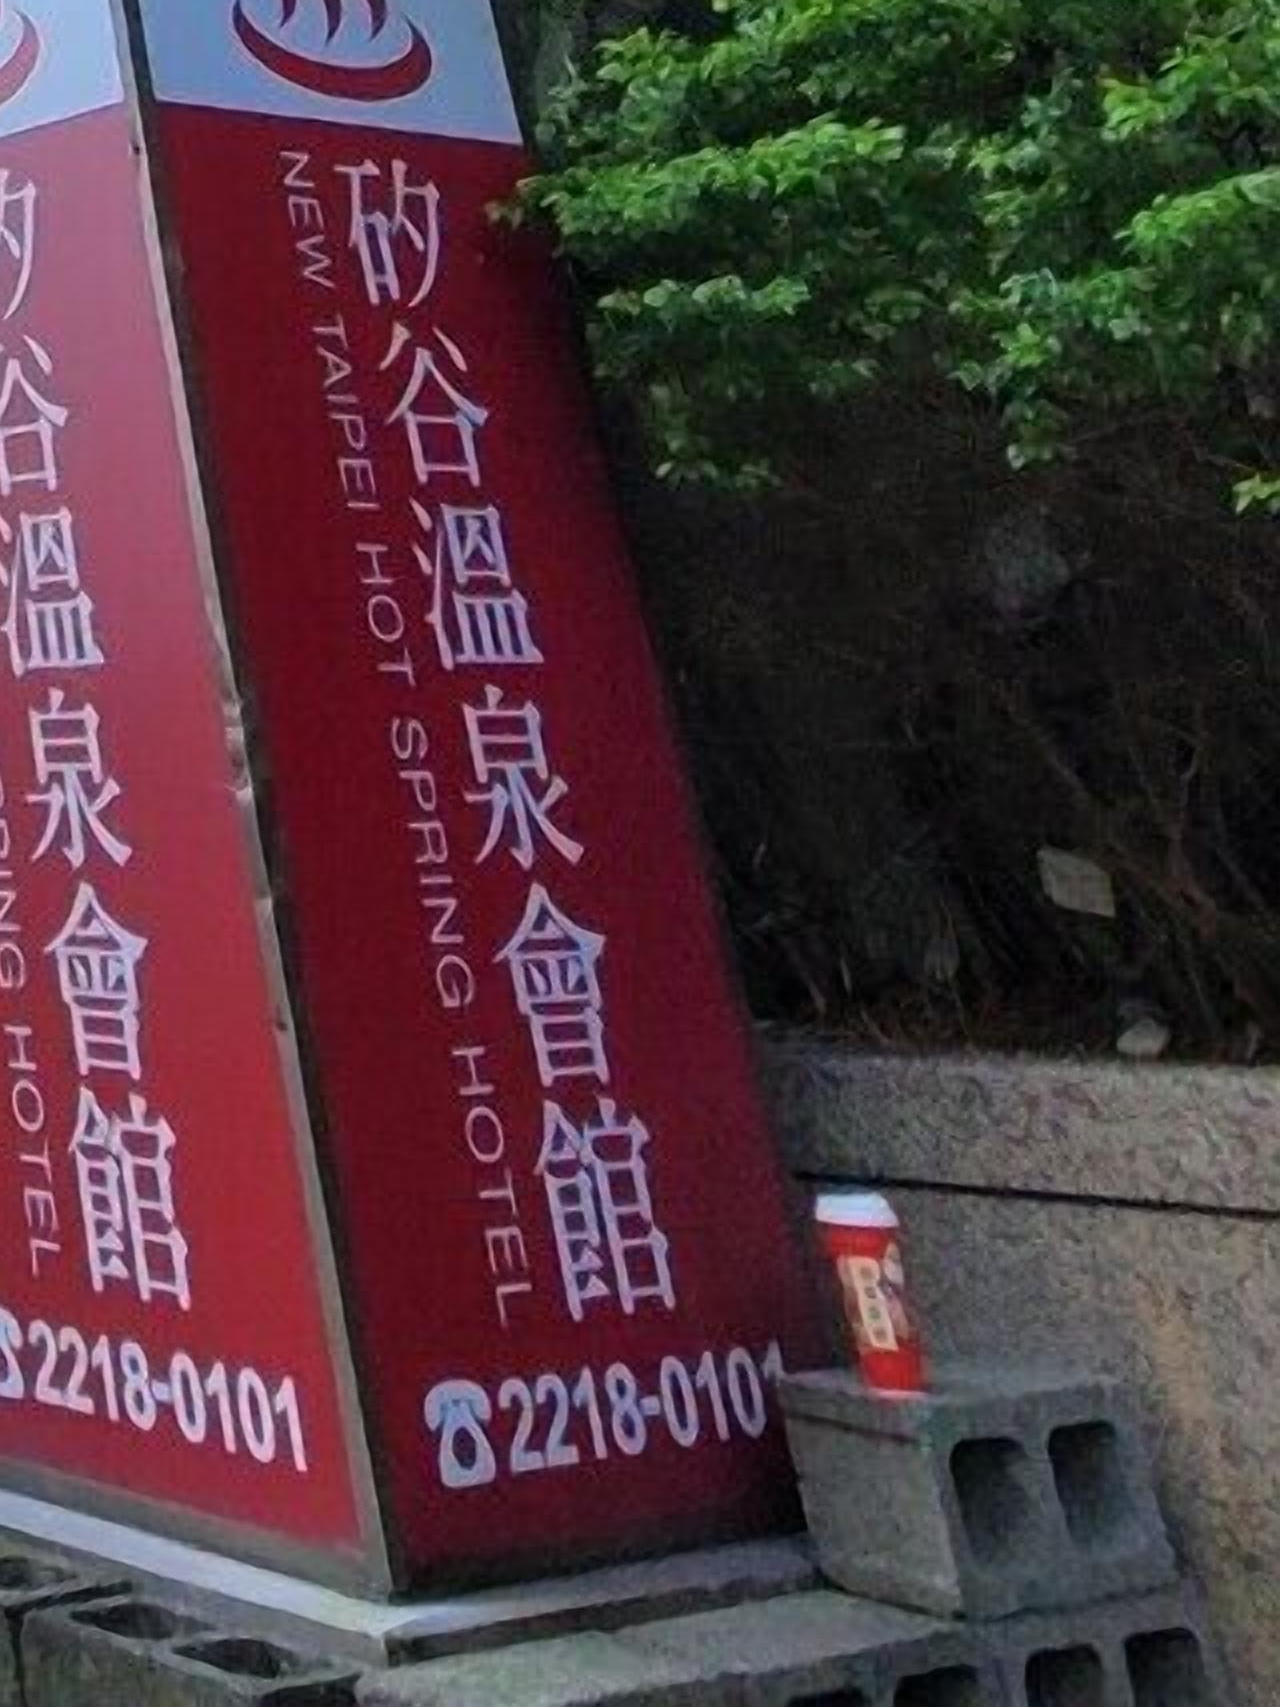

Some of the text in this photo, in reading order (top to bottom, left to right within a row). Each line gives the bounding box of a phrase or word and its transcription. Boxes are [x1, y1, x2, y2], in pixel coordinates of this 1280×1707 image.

[279, 150, 533, 1329] NEW TAIPEI HOT SPRING HOTEL
[333, 158, 676, 1323] 矽谷溫泉會館
[3, 1023, 61, 1277] HOTEL
[28, 1318, 308, 1473] 2218-0101
